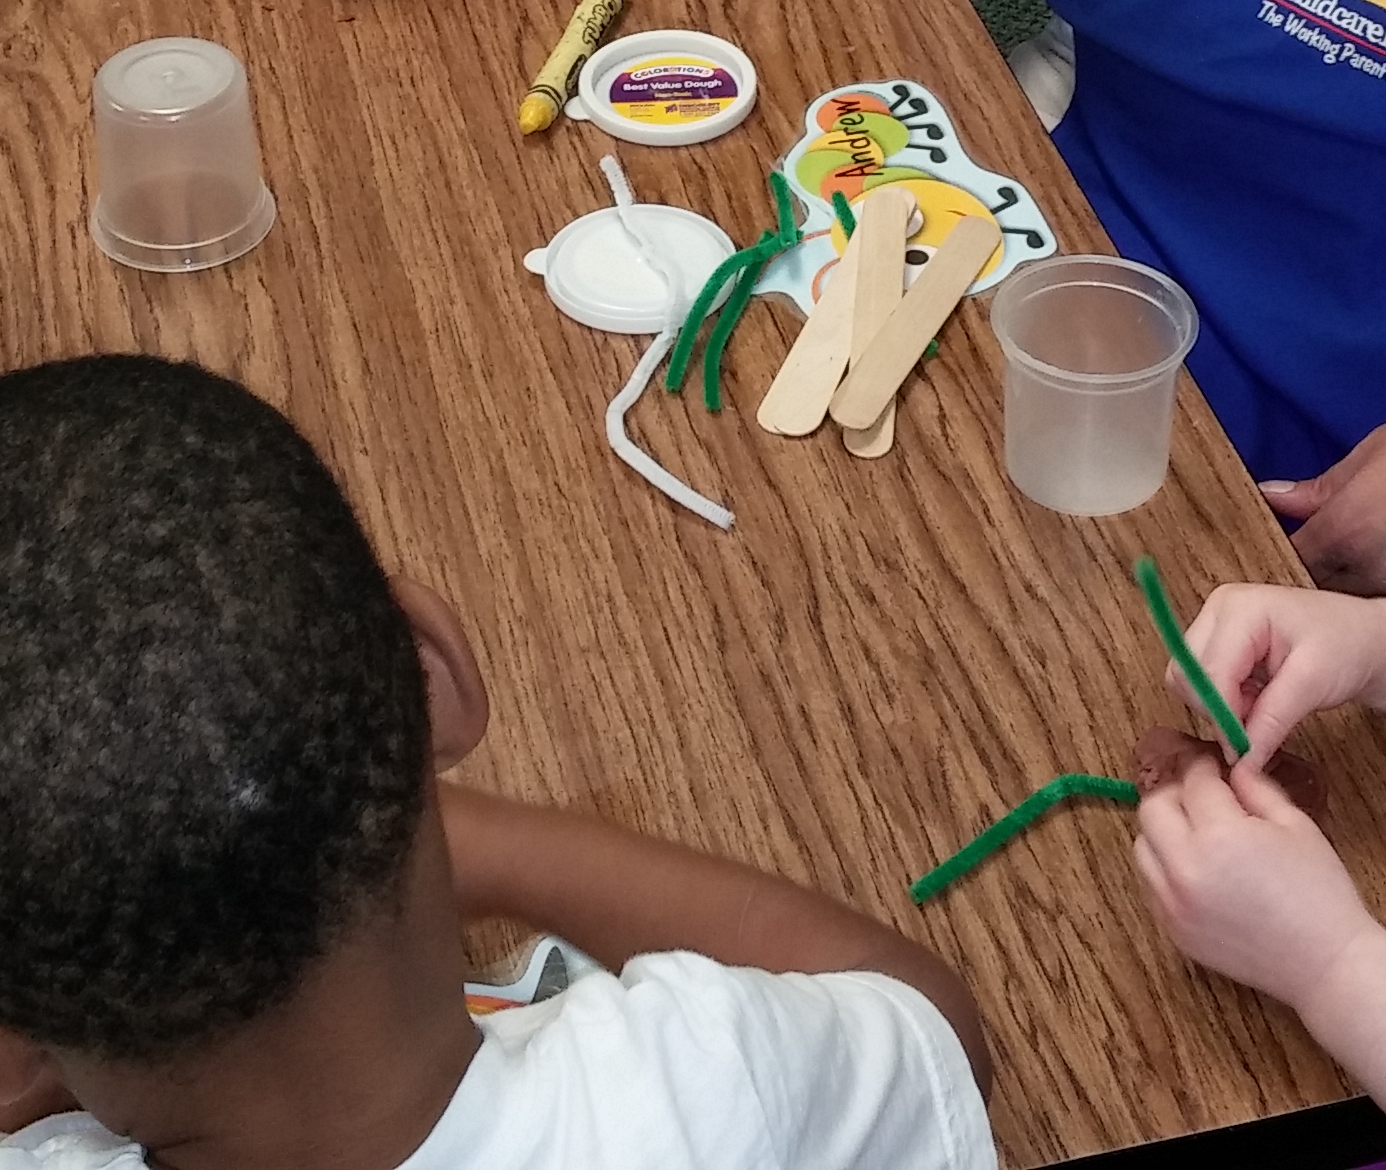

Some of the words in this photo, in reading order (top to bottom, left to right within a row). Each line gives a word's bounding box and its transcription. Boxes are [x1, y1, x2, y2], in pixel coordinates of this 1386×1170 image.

[1257, 0, 1283, 27] The
[1284, 14, 1340, 64] Working
[623, 83, 648, 91] Best
[650, 82, 682, 90] Value
[684, 79, 722, 89] Dough
[828, 98, 885, 179] Andrew
